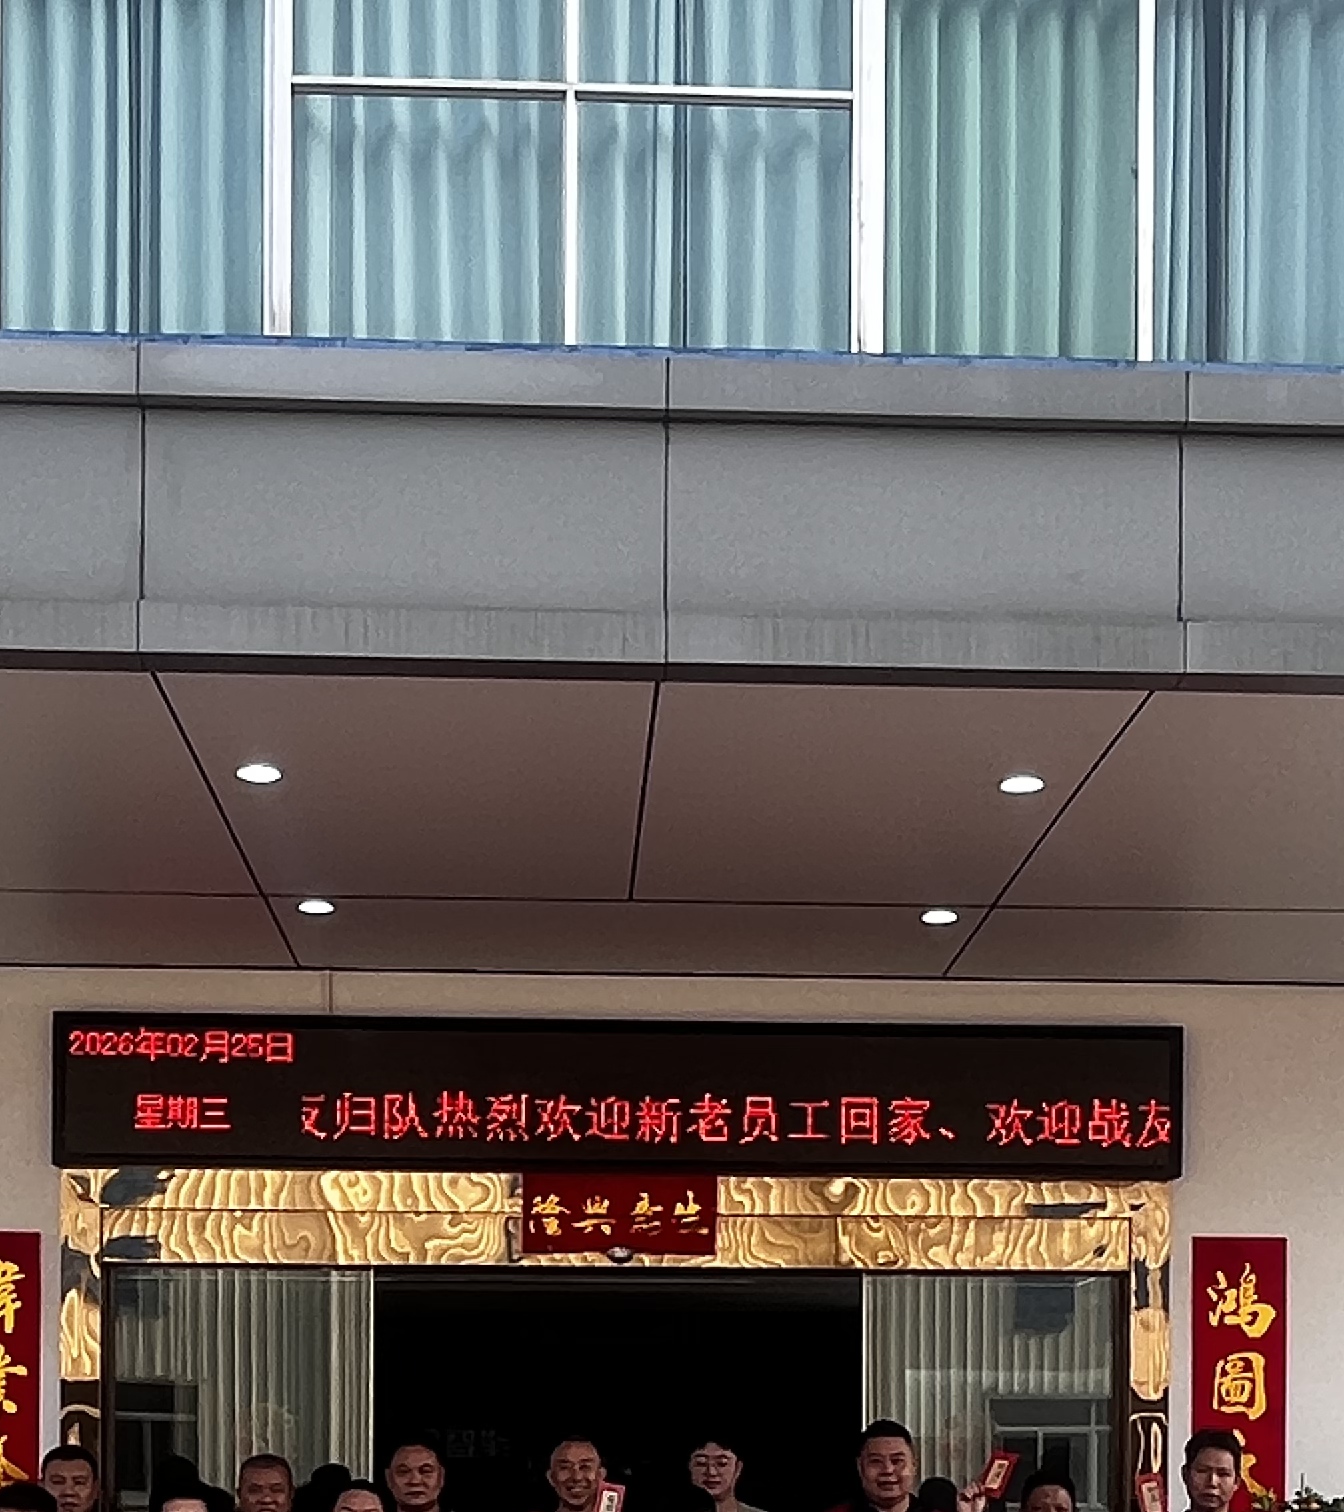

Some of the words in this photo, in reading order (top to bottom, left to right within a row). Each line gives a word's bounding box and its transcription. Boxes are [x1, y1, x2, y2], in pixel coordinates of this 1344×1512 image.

[68, 1028, 295, 1063] 2026年02月25日
[133, 1093, 233, 1131] 星期三
